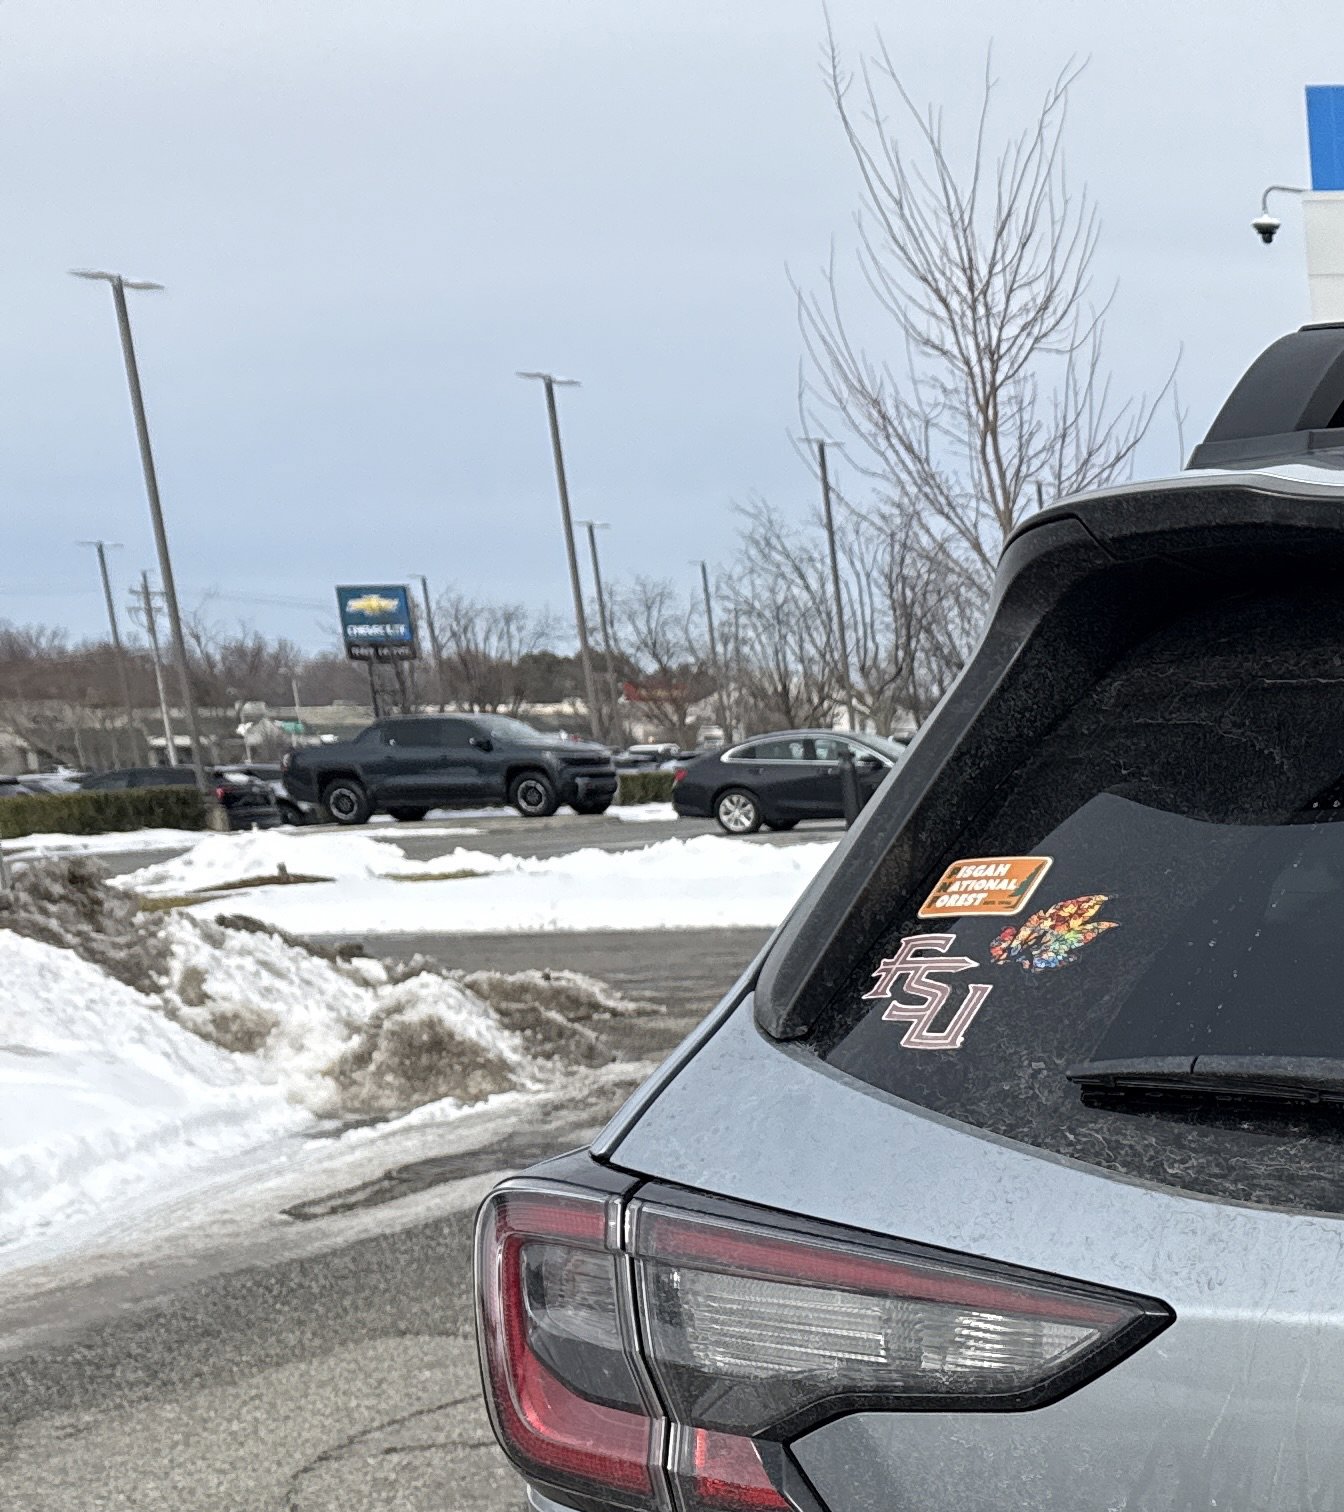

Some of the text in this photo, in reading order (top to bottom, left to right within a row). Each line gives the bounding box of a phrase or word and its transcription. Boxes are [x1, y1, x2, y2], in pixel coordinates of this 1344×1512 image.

[947, 864, 1011, 879] PISGAH
[937, 879, 1018, 893] NATIONAL
[926, 893, 988, 908] FOREST
[862, 933, 993, 1048] FSU
